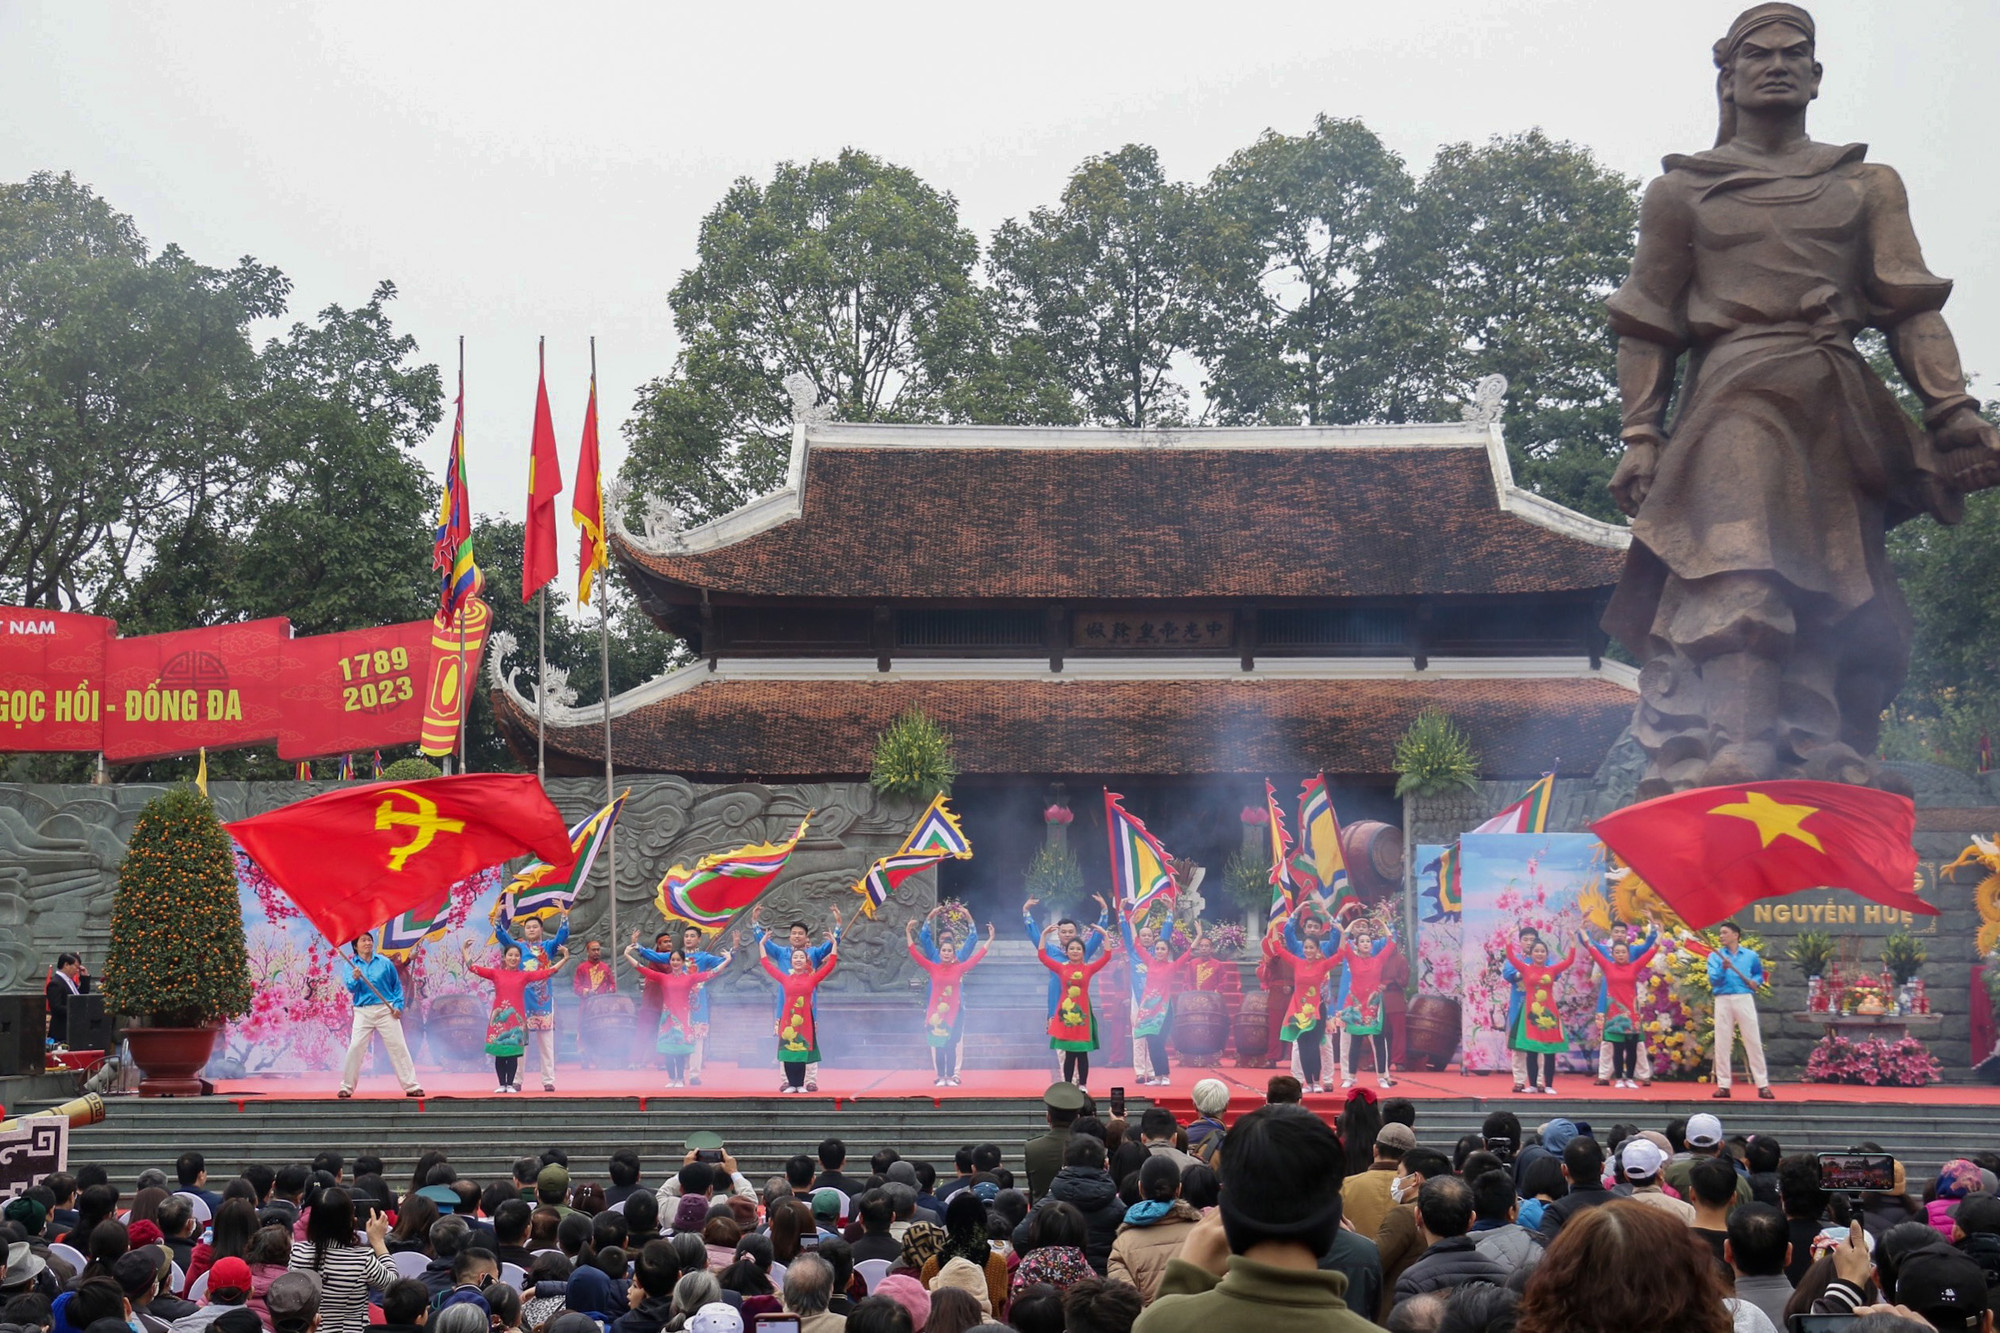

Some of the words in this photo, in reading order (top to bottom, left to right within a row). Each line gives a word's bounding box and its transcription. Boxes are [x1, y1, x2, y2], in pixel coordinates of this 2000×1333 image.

[9, 620, 56, 634] NAM
[338, 646, 409, 681] 1789
[55, 678, 100, 722] HỒI
[124, 678, 198, 721] ĐỐNG
[206, 689, 242, 721] ĐA
[342, 676, 413, 712] 2023
[1753, 898, 1857, 924] NGUYỄN
